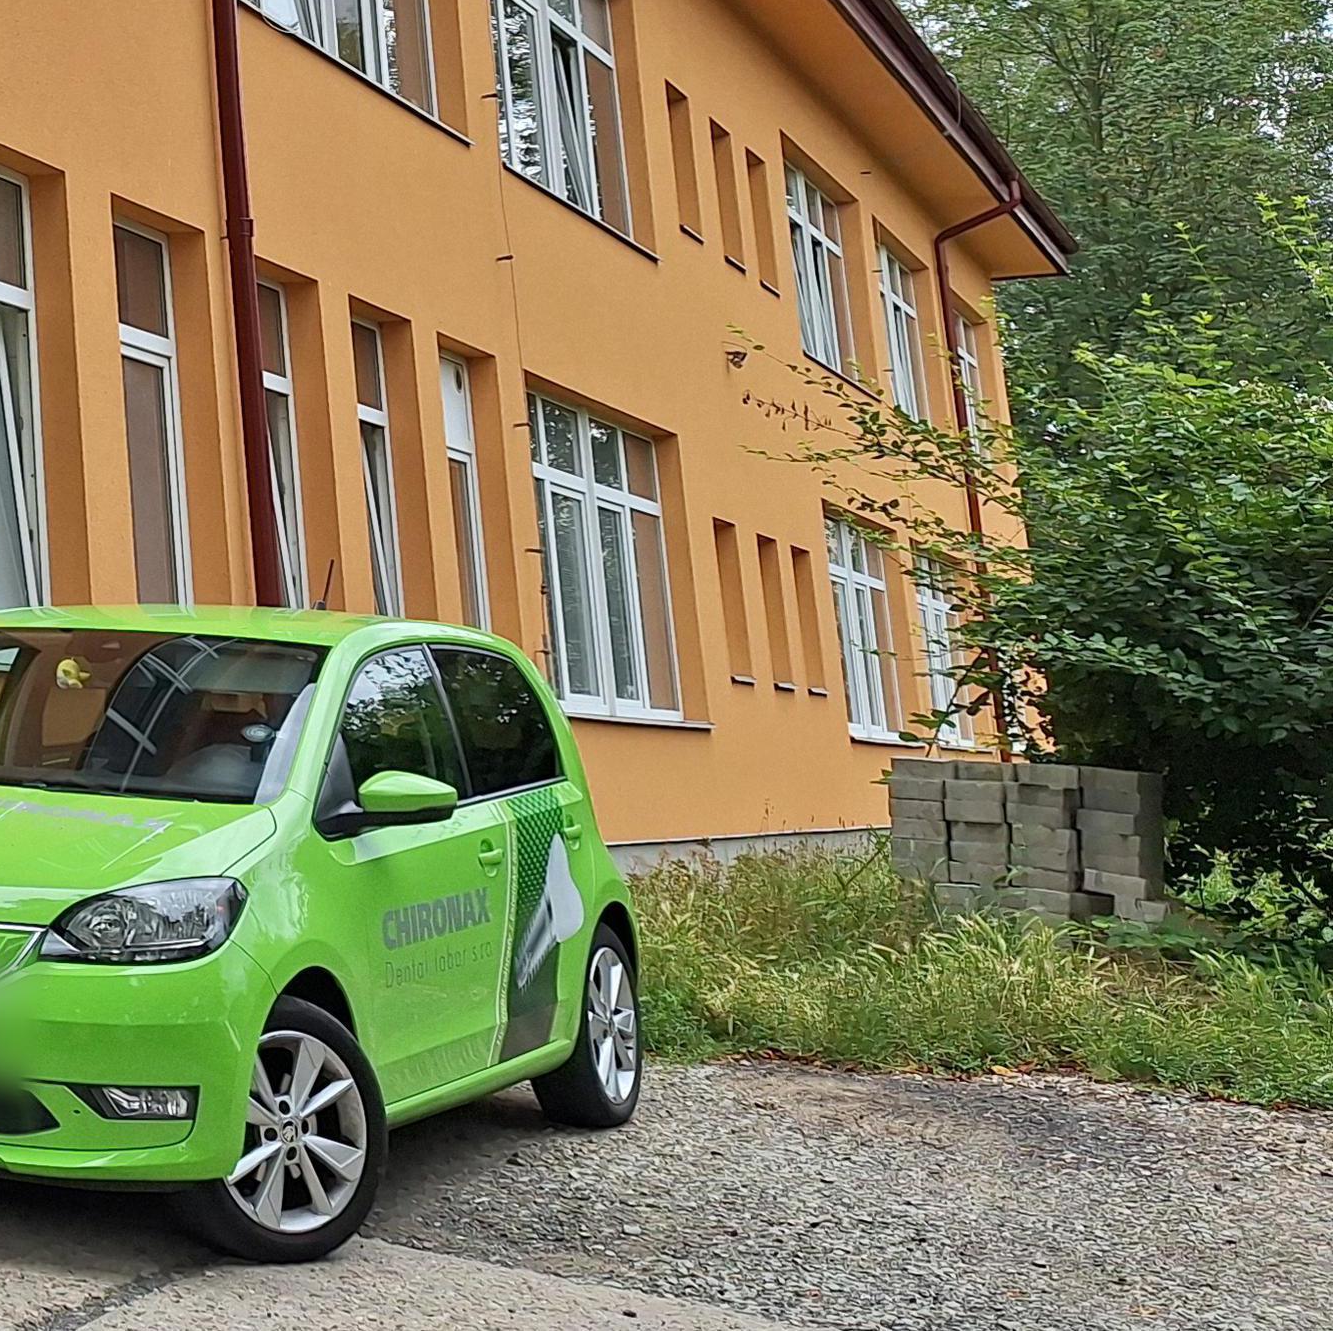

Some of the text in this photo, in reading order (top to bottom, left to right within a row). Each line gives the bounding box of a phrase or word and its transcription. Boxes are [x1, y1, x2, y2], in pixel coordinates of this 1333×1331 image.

[383, 887, 490, 950] CHIRONAX
[385, 950, 429, 988] Dental
[435, 945, 467, 972] labor
